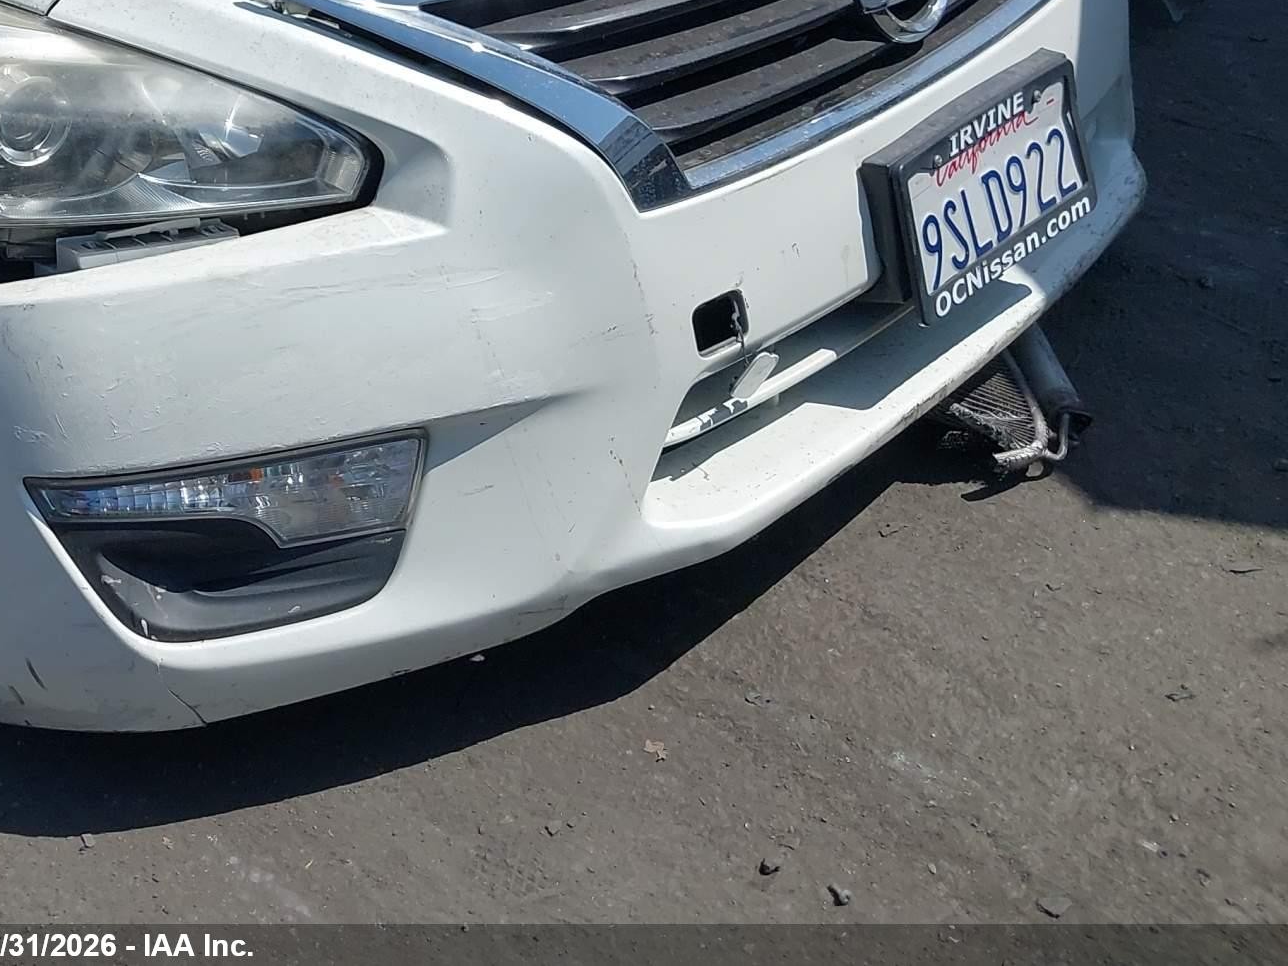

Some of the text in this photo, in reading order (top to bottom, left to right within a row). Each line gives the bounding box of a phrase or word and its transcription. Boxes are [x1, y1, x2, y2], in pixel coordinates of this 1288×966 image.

[935, 110, 1039, 187] California
[949, 91, 1024, 157] IRVINE
[922, 128, 1078, 291] 9SLD922
[935, 195, 1091, 318] OCNissan.com
